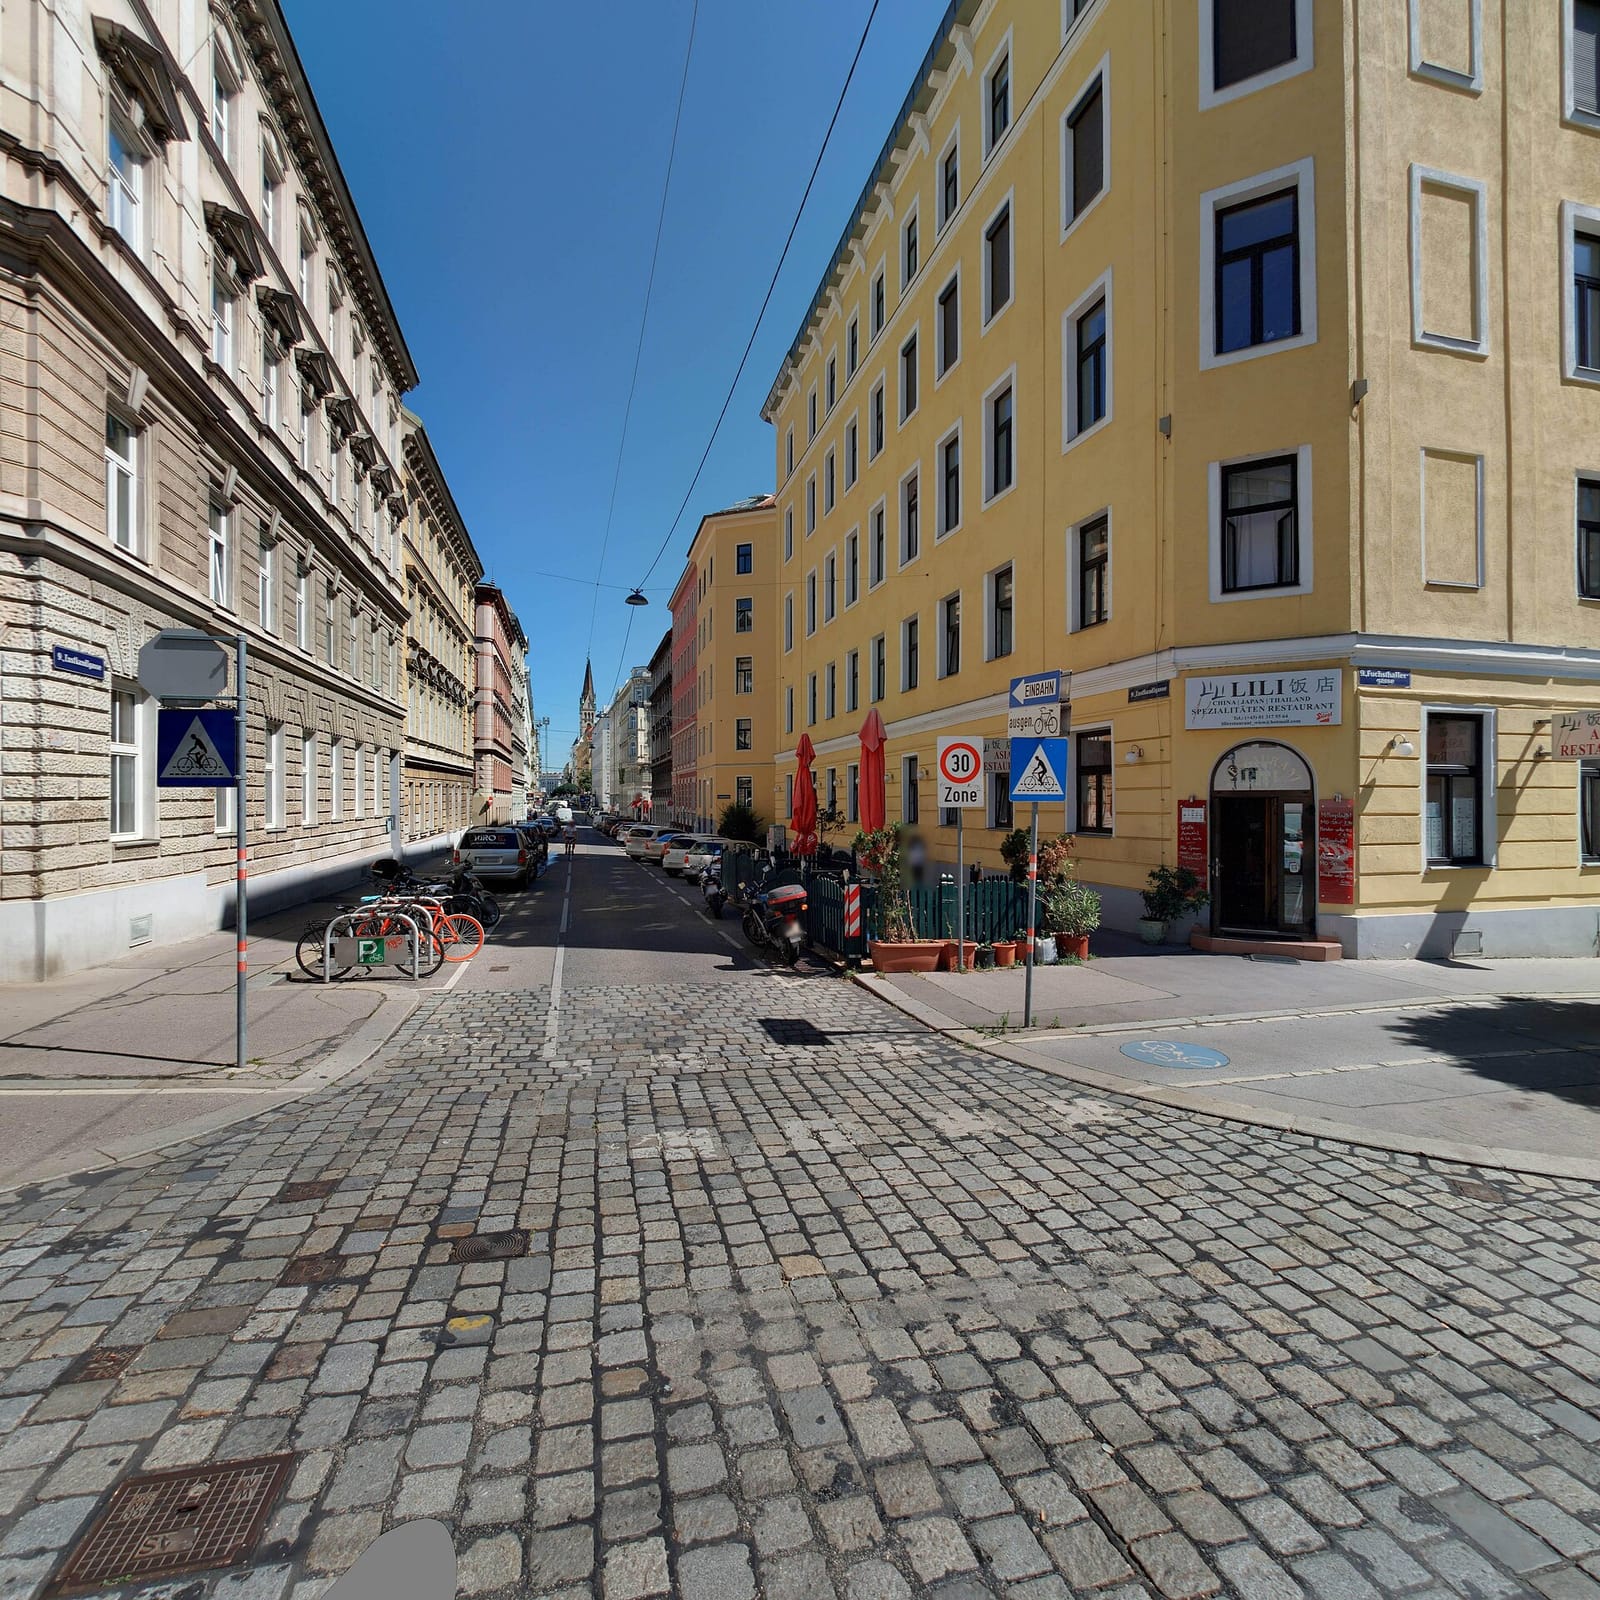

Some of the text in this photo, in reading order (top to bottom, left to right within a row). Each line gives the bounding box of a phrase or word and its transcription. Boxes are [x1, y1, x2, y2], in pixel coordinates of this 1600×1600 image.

[1025, 681, 1055, 698] EINBAHN
[1231, 679, 1284, 698] LILI
[1191, 702, 1335, 715] SPEZIALITÄTEN RESTAURANT
[1270, 696, 1311, 704] THAILAND
[1009, 716, 1034, 731] ausgen.
[951, 754, 970, 773] 30
[944, 786, 977, 803] Zone
[359, 940, 378, 962] P
